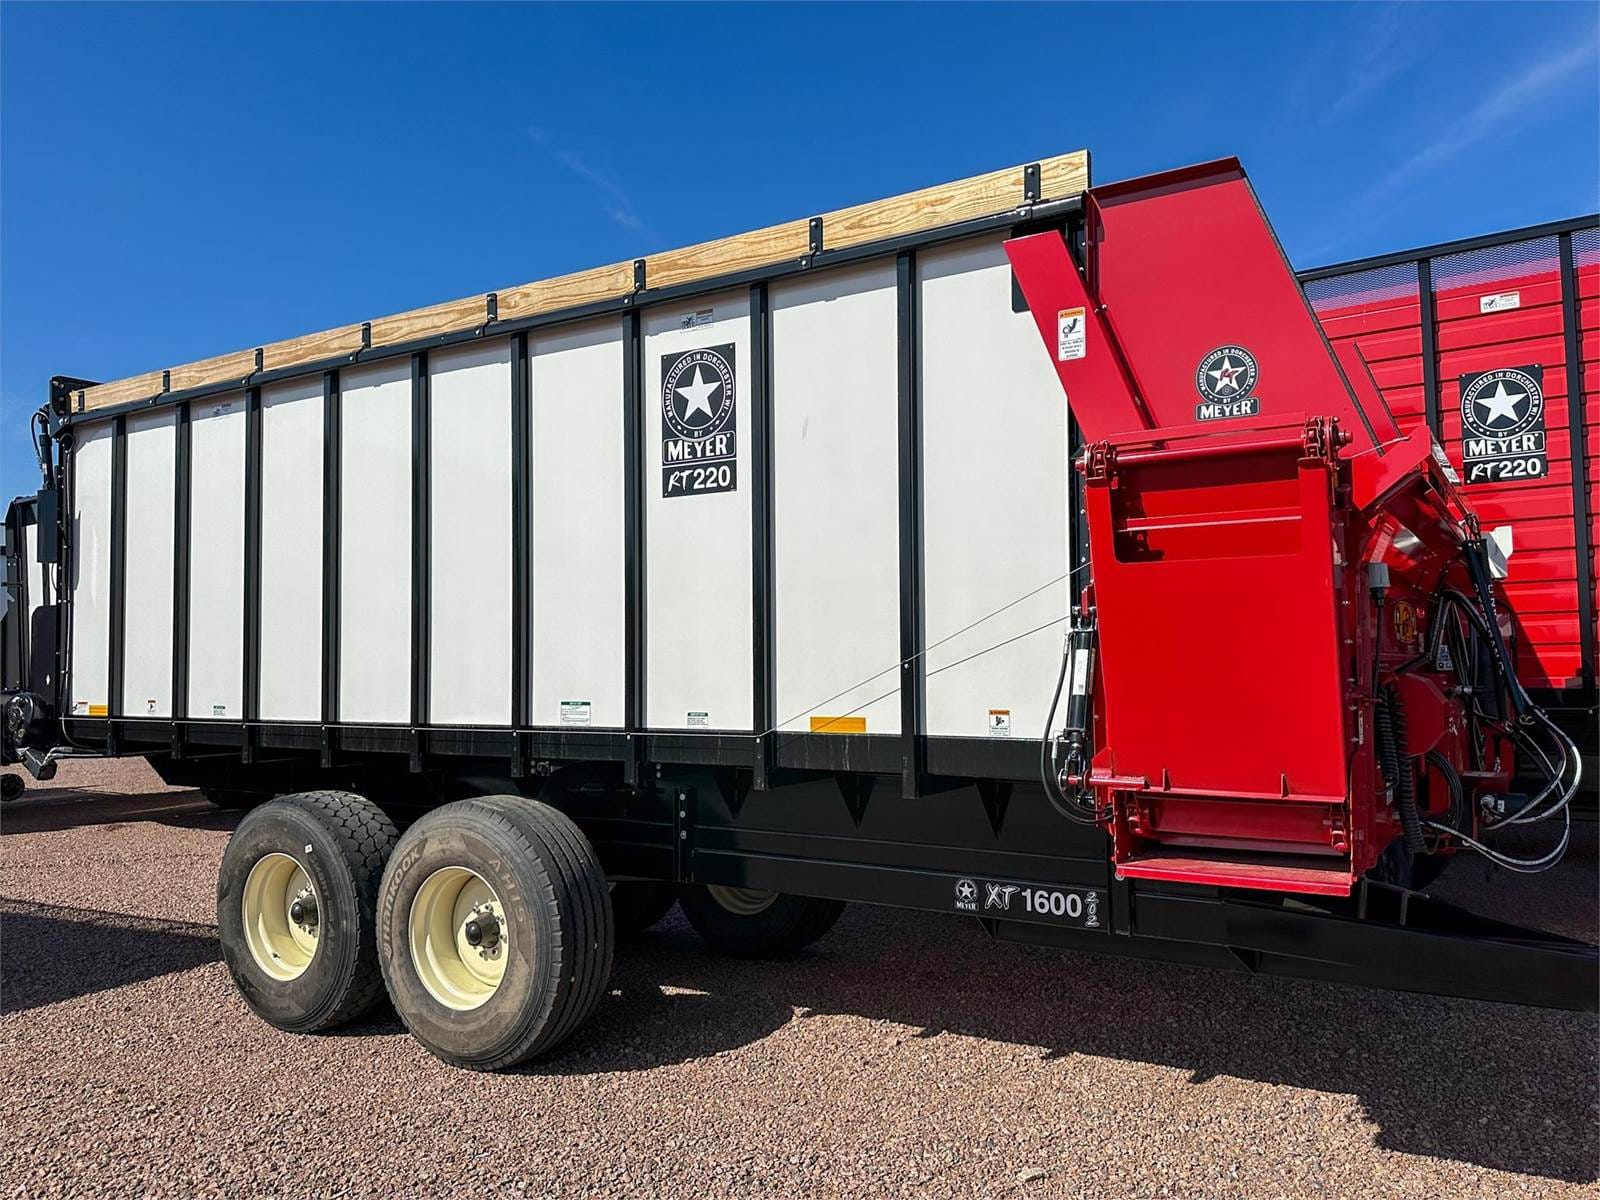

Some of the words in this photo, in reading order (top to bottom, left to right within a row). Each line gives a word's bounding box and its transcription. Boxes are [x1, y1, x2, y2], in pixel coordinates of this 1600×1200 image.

[665, 356, 692, 418] MANUFACTURED
[693, 353, 701, 361] IN
[703, 353, 732, 396] DORCHESTER
[723, 399, 732, 410] WI
[1464, 375, 1493, 423] MANUFACTURED
[1506, 371, 1540, 405] DORCHESTER
[1530, 406, 1539, 416] WI
[1200, 400, 1252, 419] MEYER
[668, 434, 727, 461] MEYER
[694, 430, 703, 438] BY
[1468, 434, 1535, 457] MEYER
[1021, 888, 1082, 918] 1600
